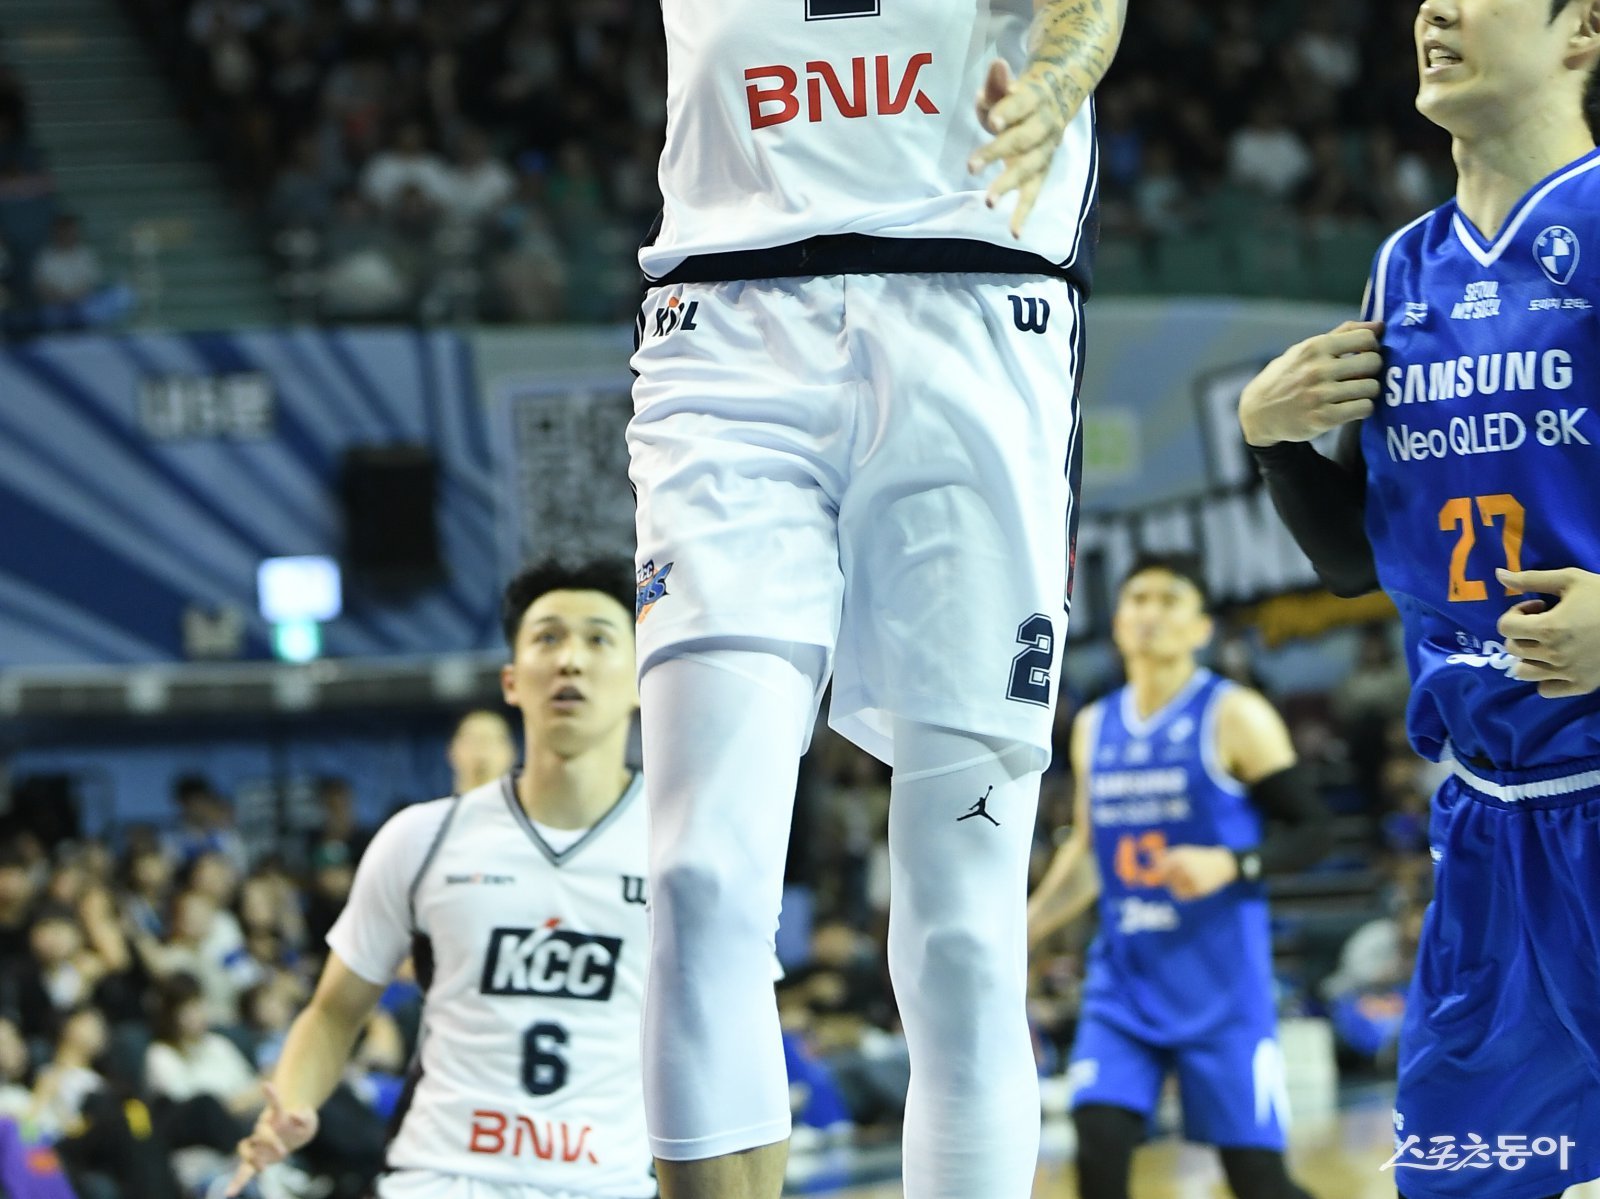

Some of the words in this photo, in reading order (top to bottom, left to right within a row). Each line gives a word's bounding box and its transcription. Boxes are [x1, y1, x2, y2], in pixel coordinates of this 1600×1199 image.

[744, 53, 940, 131] BNK
[1385, 349, 1573, 407] SAMSUNG
[1535, 407, 1592, 447] 8K
[1438, 493, 1526, 601] 27
[1005, 612, 1055, 710] 2
[492, 918, 613, 996] KCC
[521, 1020, 570, 1097] 6
[470, 1109, 599, 1164] BNK
